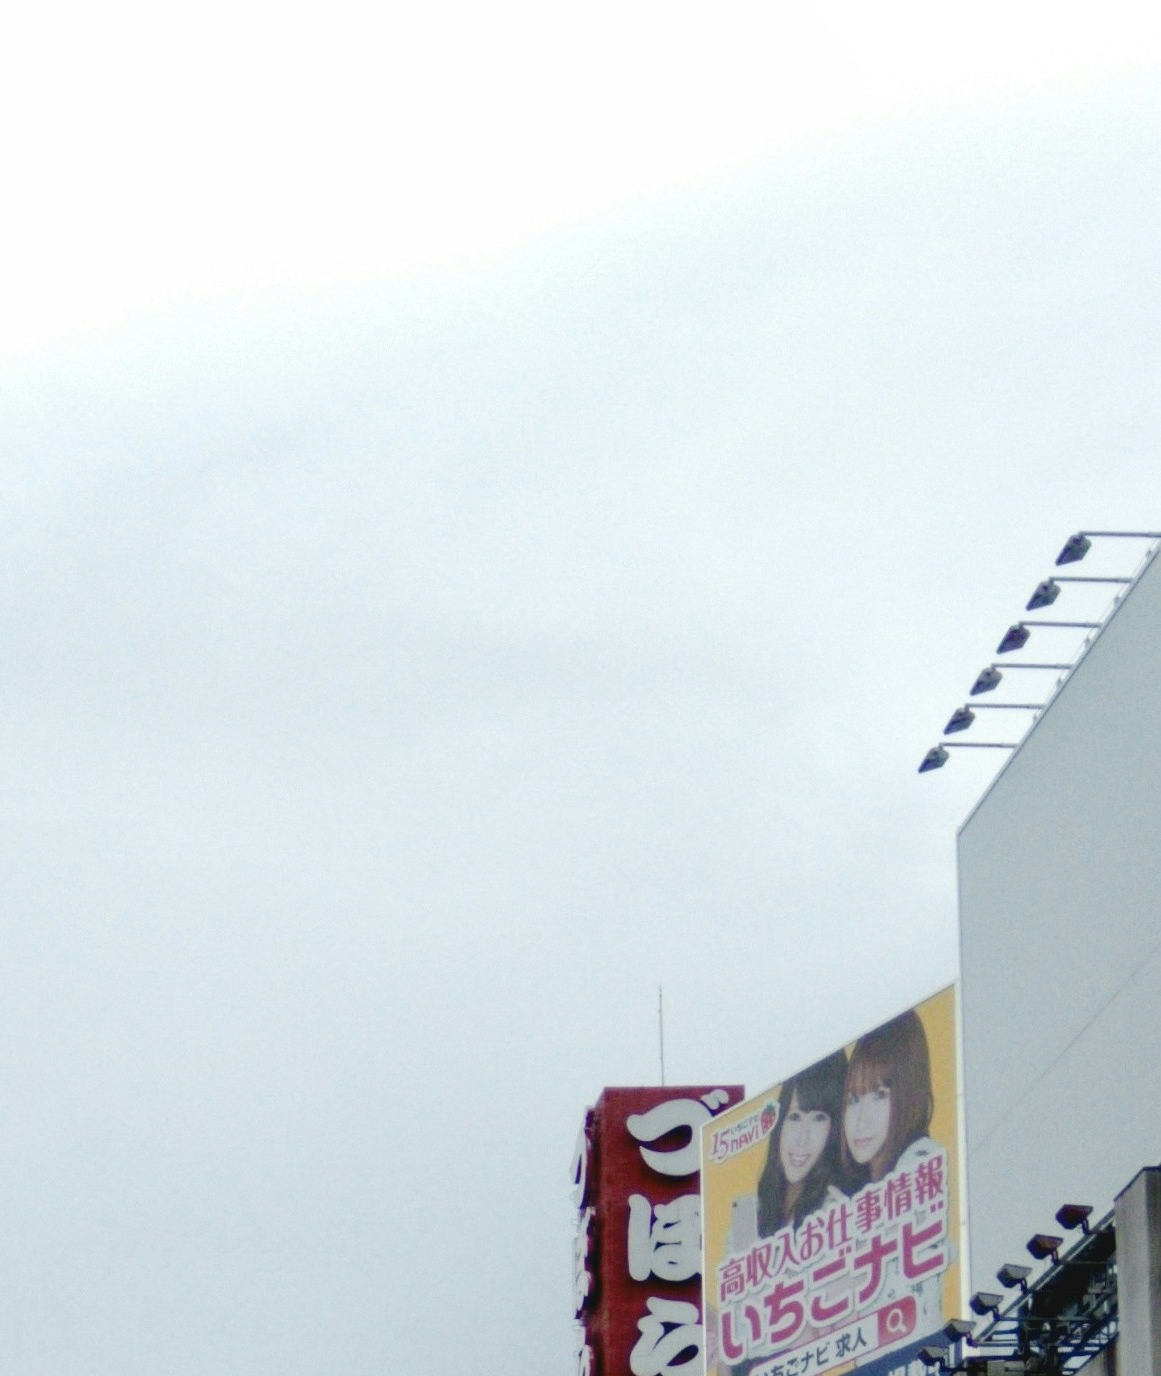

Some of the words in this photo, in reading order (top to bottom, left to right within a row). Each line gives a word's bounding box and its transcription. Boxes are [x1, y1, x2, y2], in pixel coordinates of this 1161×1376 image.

[720, 1154, 944, 1302] 高収入お仕事情報
[721, 1202, 945, 1360] いちごナビ
[836, 1326, 869, 1359] 求人
